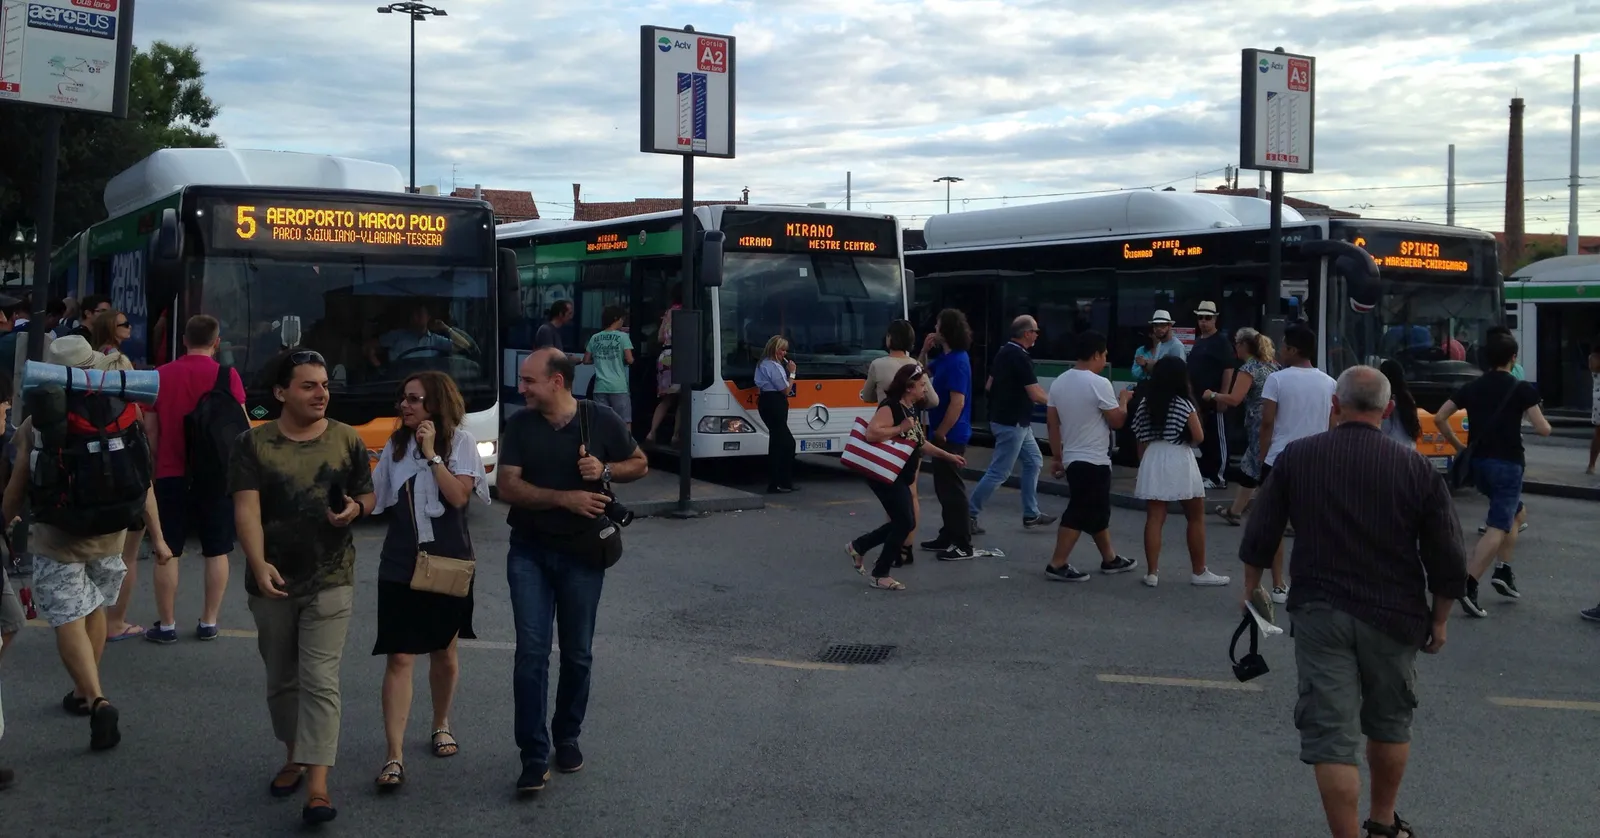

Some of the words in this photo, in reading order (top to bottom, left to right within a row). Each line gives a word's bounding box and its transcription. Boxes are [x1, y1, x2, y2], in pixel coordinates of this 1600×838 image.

[93, 0, 111, 9] lane
[28, 4, 109, 29] aeroBUS
[674, 40, 692, 50] Actv
[700, 38, 723, 48] Corsia
[700, 47, 723, 65] A2
[1290, 67, 1307, 84] A3
[6, 83, 12, 91] 5
[236, 205, 256, 239] 5
[266, 207, 354, 228] AEROPORTO
[358, 212, 405, 230] MARCO
[410, 214, 445, 232] POLO
[273, 226, 301, 240] PARCO
[786, 222, 833, 238] MIRANO
[739, 236, 772, 247] MIRANO
[809, 239, 841, 250] MESTRE
[1124, 243, 1130, 259] 6
[1152, 240, 1180, 250] SPINEA
[1400, 241, 1440, 257] SPINEA
[1173, 248, 1186, 256] Per
